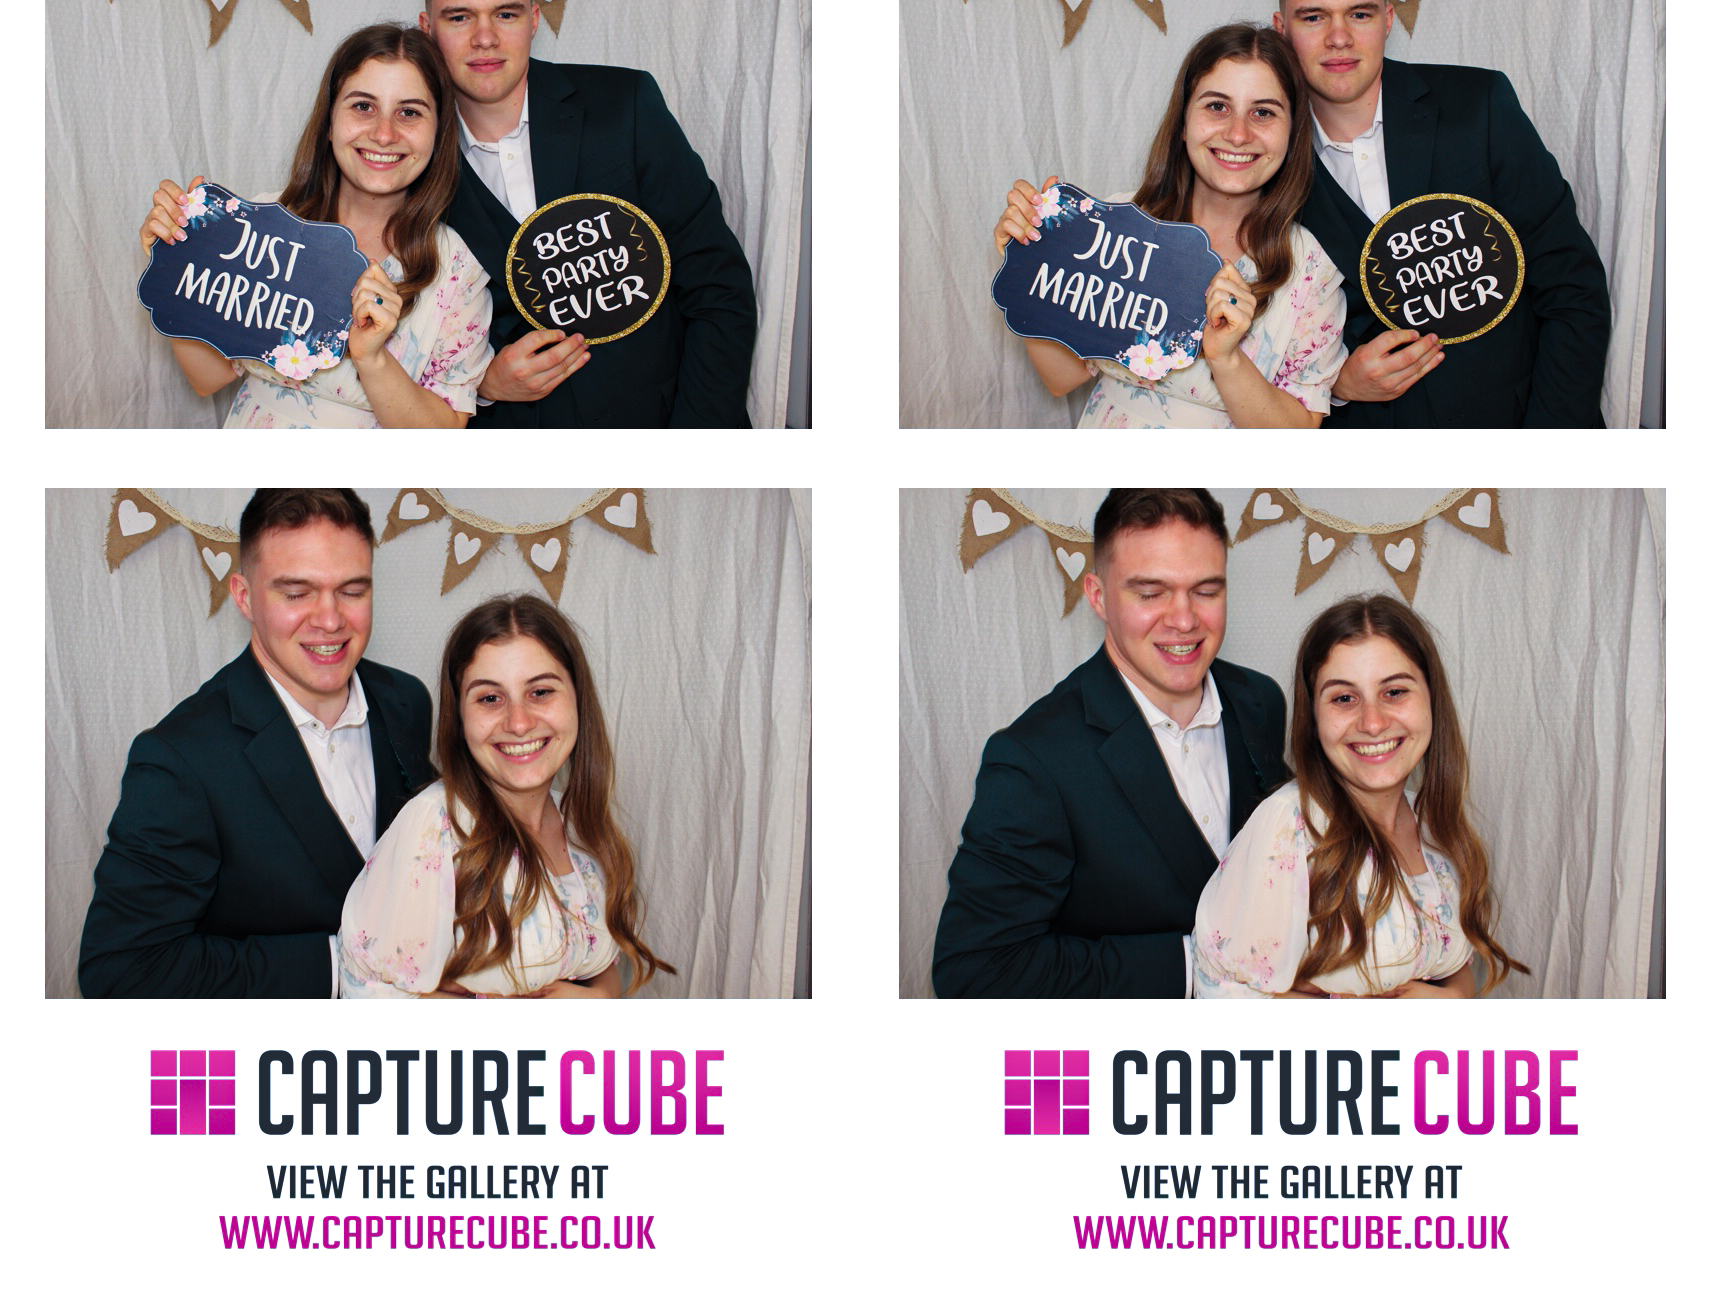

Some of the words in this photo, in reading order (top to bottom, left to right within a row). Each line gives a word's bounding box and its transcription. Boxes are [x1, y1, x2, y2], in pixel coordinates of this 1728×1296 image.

[219, 218, 306, 282] JUST
[533, 211, 611, 260] BEST
[1073, 218, 1160, 282] JUST
[1387, 211, 1465, 260] BEST
[174, 262, 315, 335] MARRIED
[549, 275, 650, 326] EVER
[1028, 262, 1169, 335] MARRIED
[1403, 275, 1504, 326] EVER
